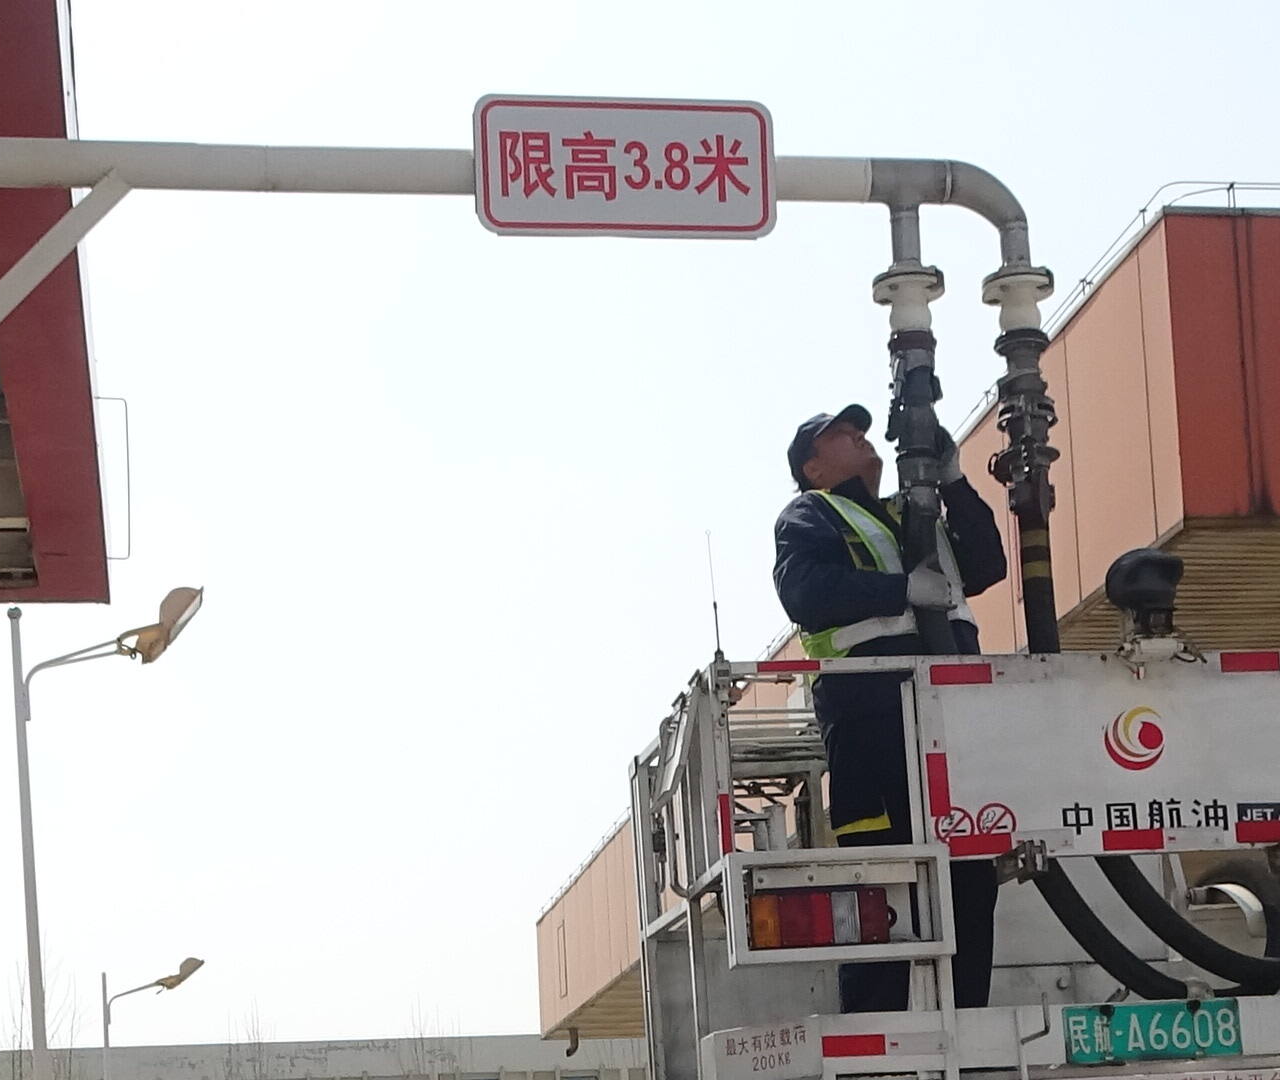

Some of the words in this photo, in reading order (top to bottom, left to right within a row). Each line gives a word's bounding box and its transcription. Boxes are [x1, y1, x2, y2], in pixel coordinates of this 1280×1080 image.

[498, 131, 751, 203] 限高3.8米
[1062, 798, 1229, 835] 中国航油
[1242, 808, 1274, 821] JET
[726, 1024, 807, 1057] 最大有效载荷
